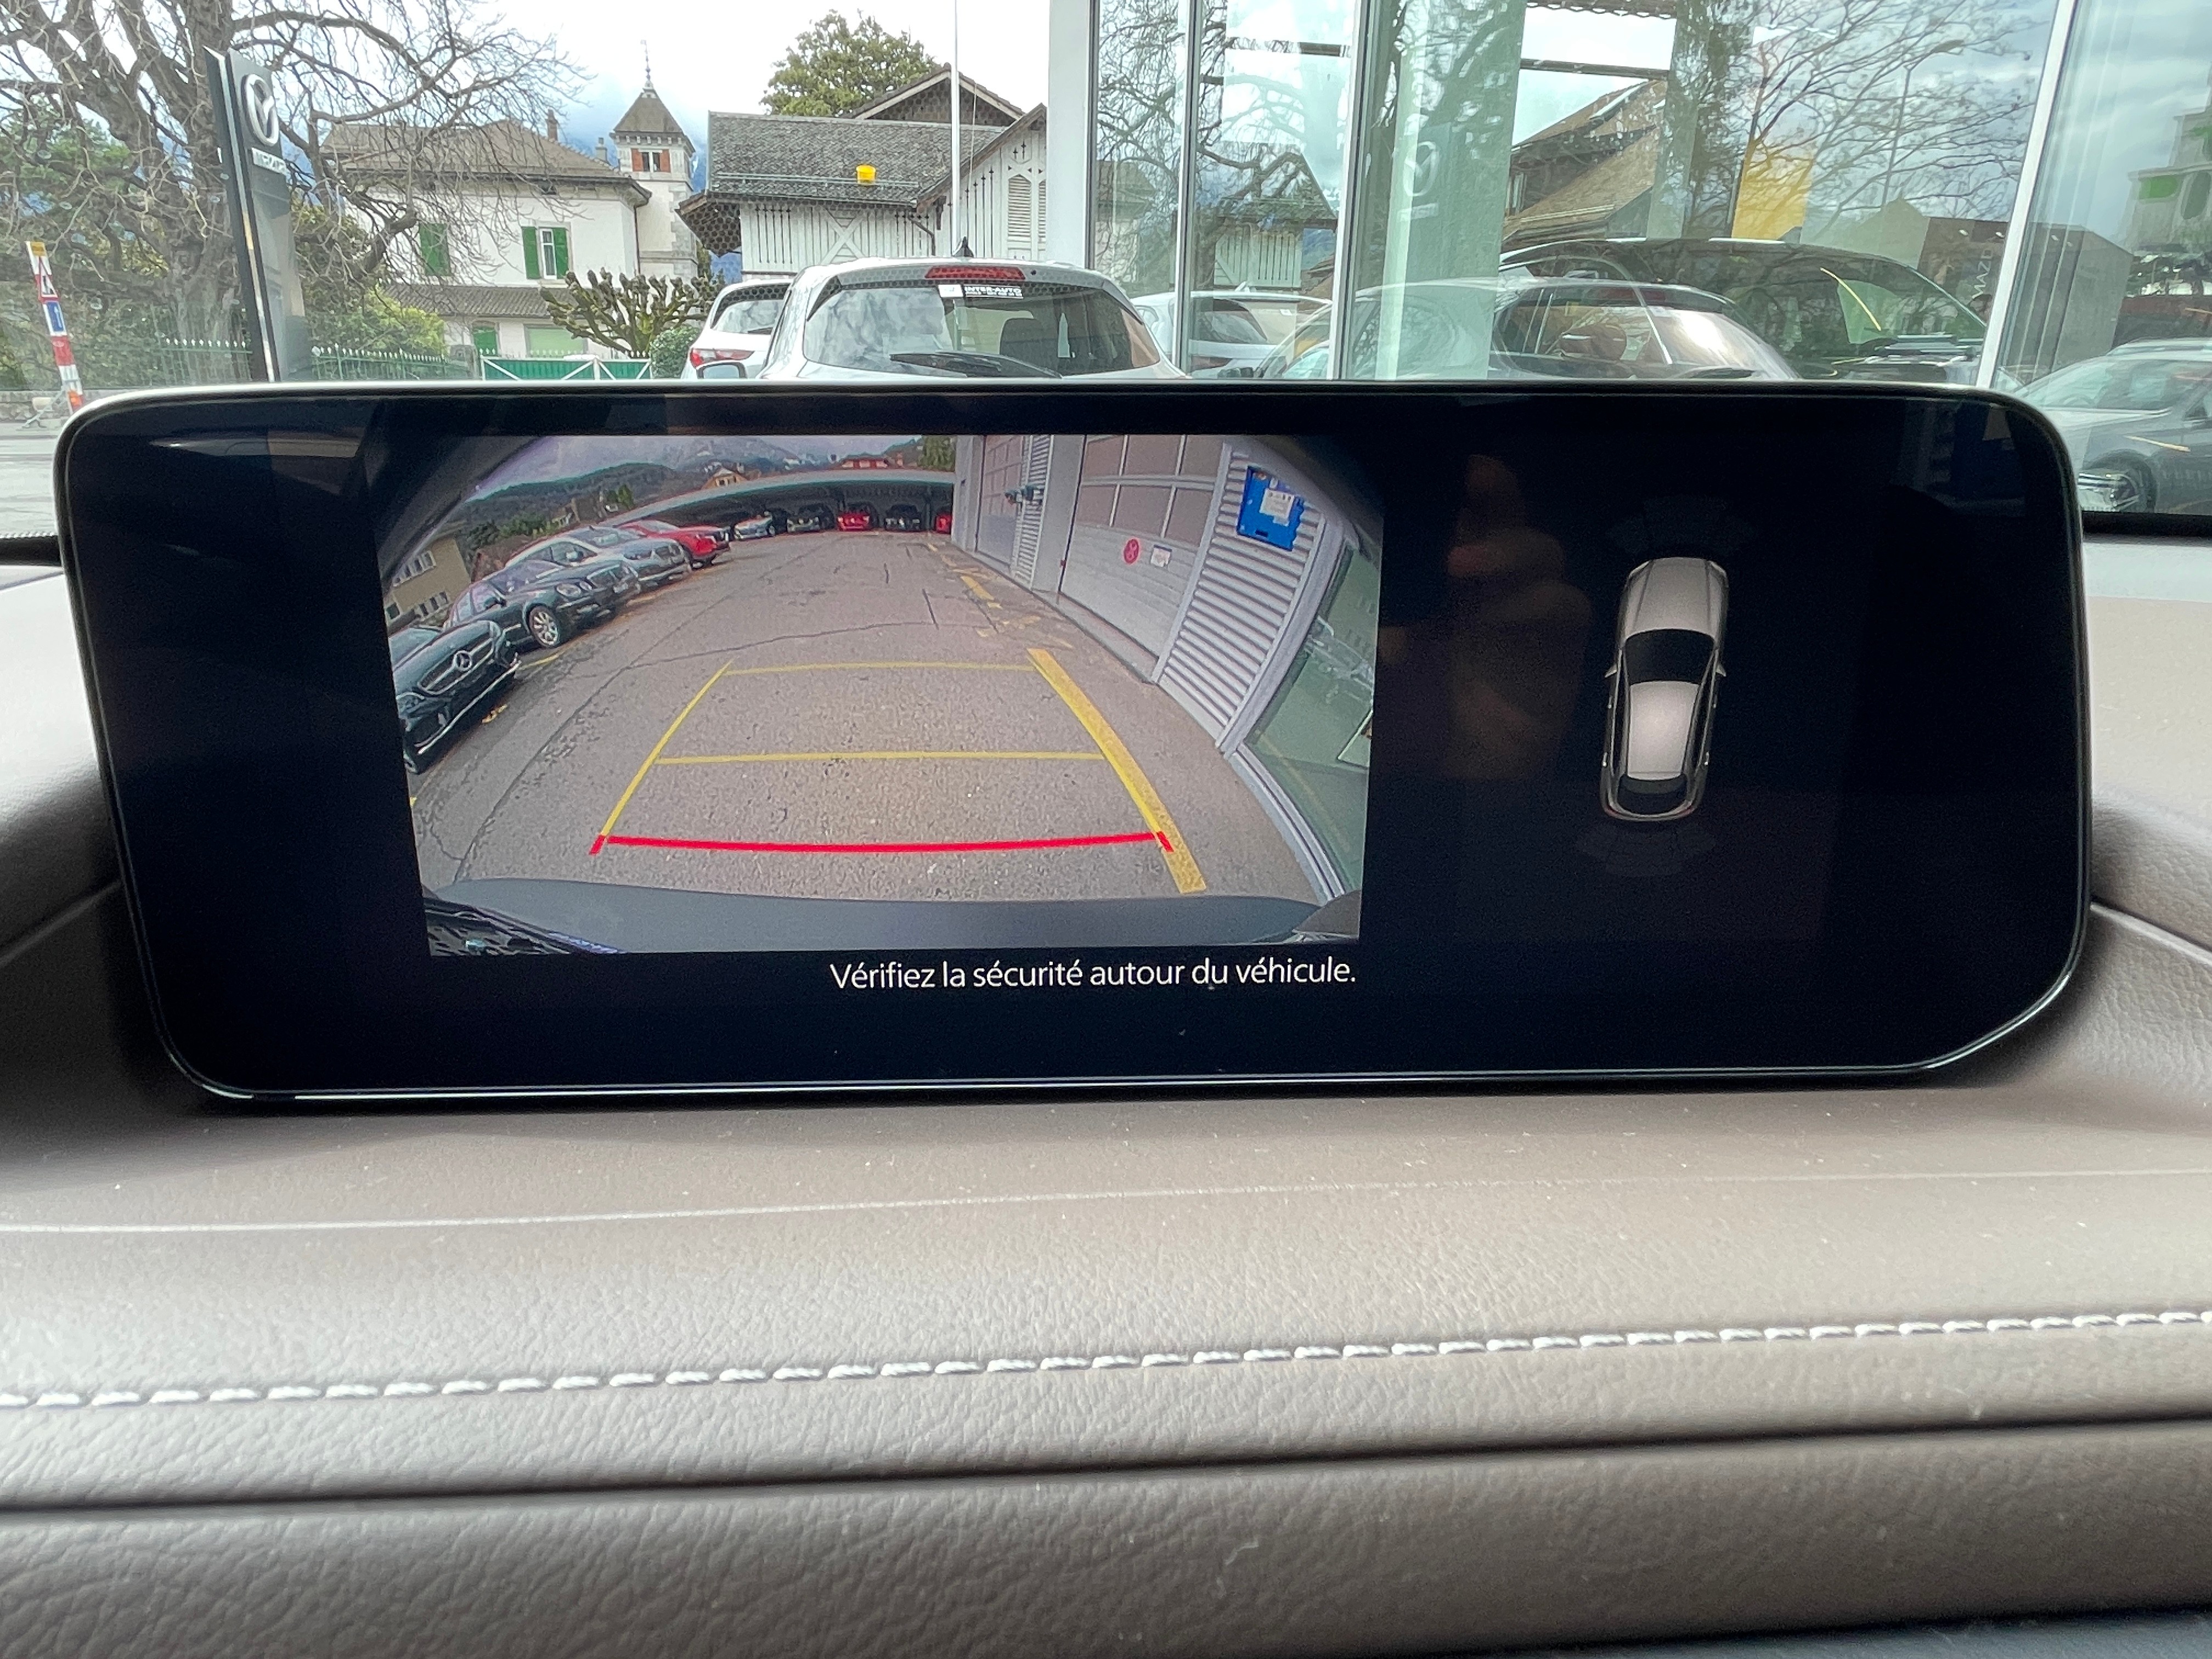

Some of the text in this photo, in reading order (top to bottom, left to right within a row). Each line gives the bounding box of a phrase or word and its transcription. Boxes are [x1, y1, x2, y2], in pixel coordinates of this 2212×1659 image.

[830, 956, 1356, 989] Vérifiez la sécurité autour du véhicule.
